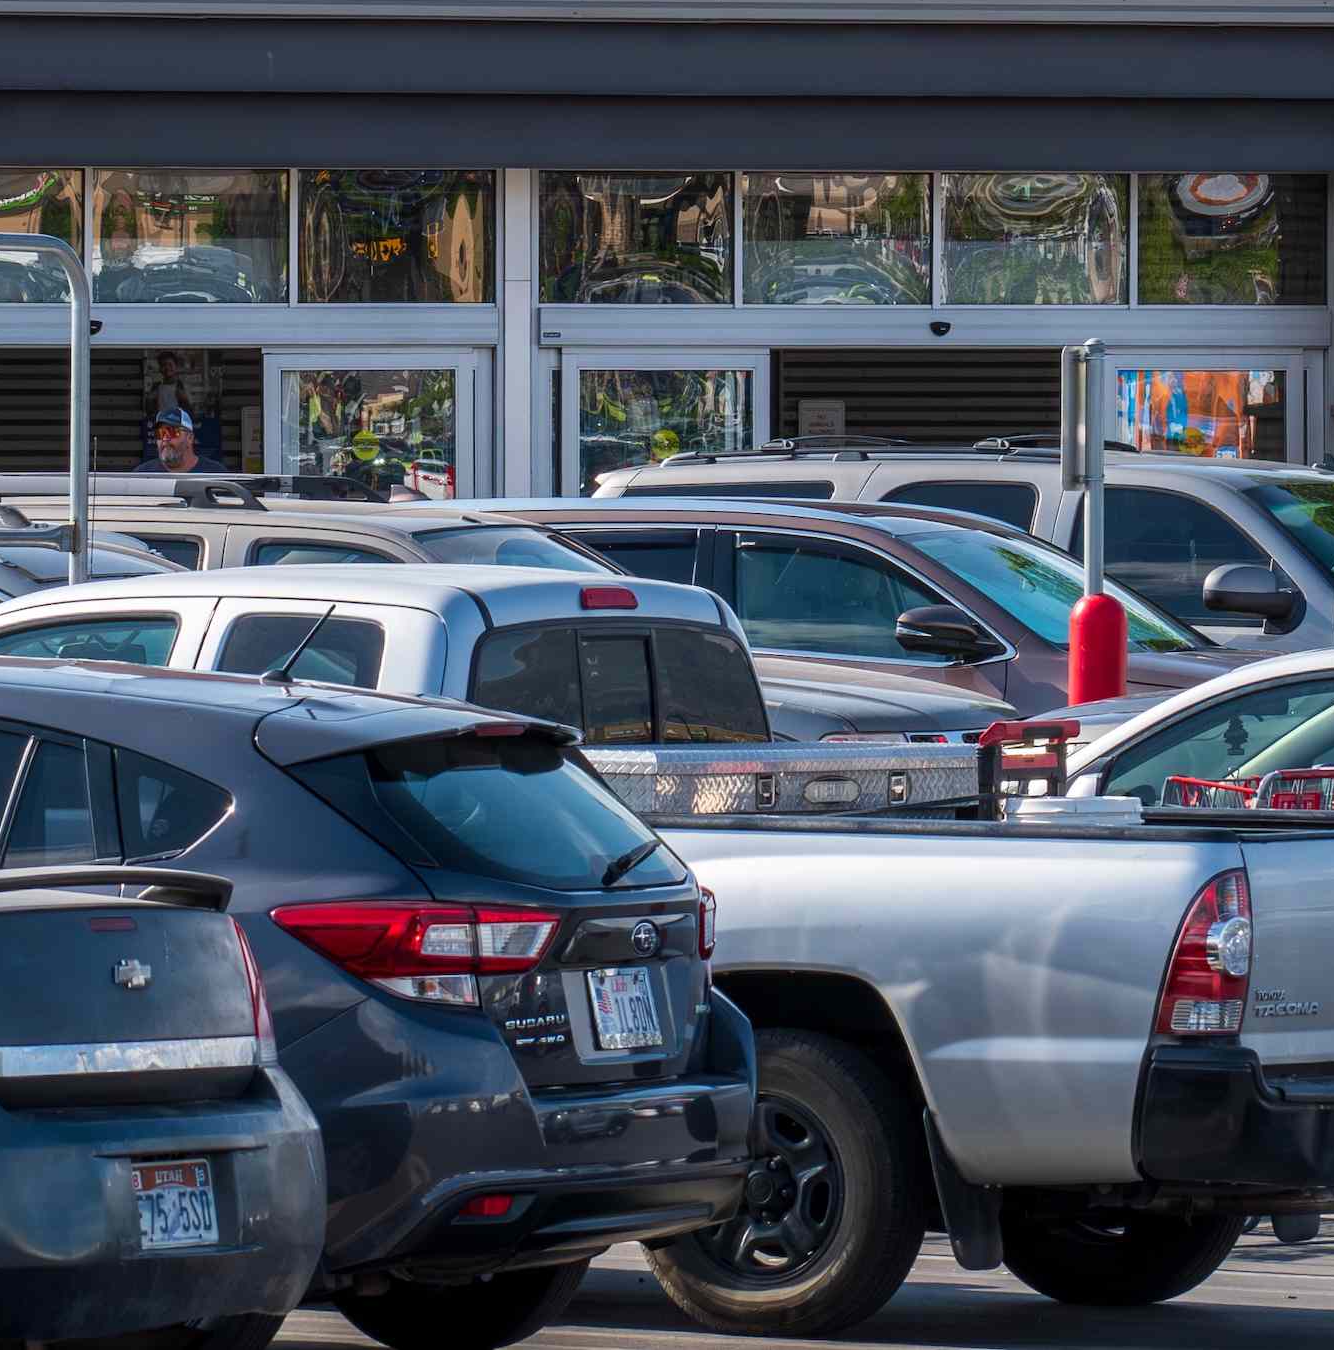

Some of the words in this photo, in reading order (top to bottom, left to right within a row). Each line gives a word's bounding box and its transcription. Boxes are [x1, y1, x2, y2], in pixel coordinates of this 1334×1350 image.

[1253, 1002, 1320, 1017] TACOMA
[505, 1014, 565, 1030] SUBARU
[154, 1168, 185, 1184] UTAH
